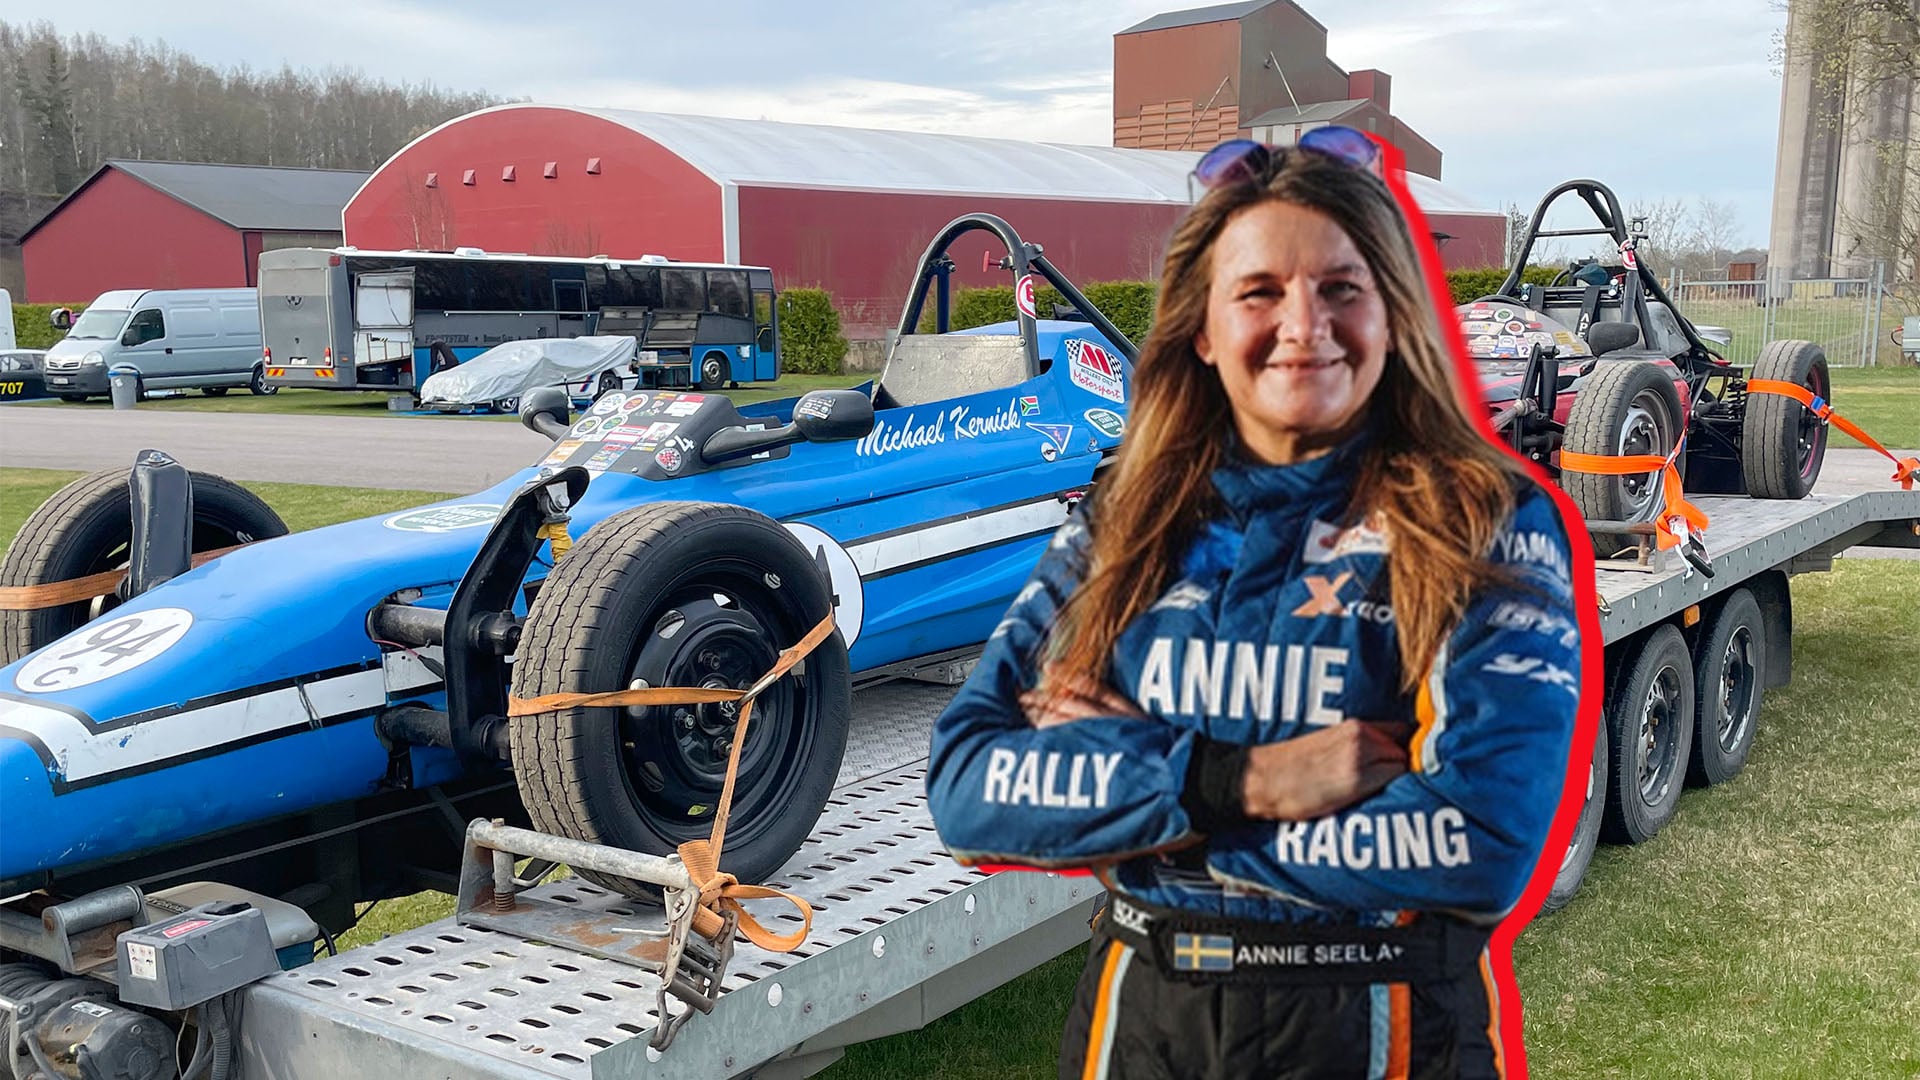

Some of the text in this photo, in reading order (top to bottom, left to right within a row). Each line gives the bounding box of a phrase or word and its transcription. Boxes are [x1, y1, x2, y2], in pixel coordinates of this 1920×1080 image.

[1073, 369, 1121, 399] Motorsport
[856, 397, 1021, 457] Michael Kernick
[58, 618, 181, 667] 94
[1137, 637, 1350, 725] ANNIE
[983, 747, 1124, 809] RALLY
[1276, 806, 1471, 871] RACING
[1235, 945, 1308, 965] ANNIE
[1314, 944, 1374, 964] SEEL
